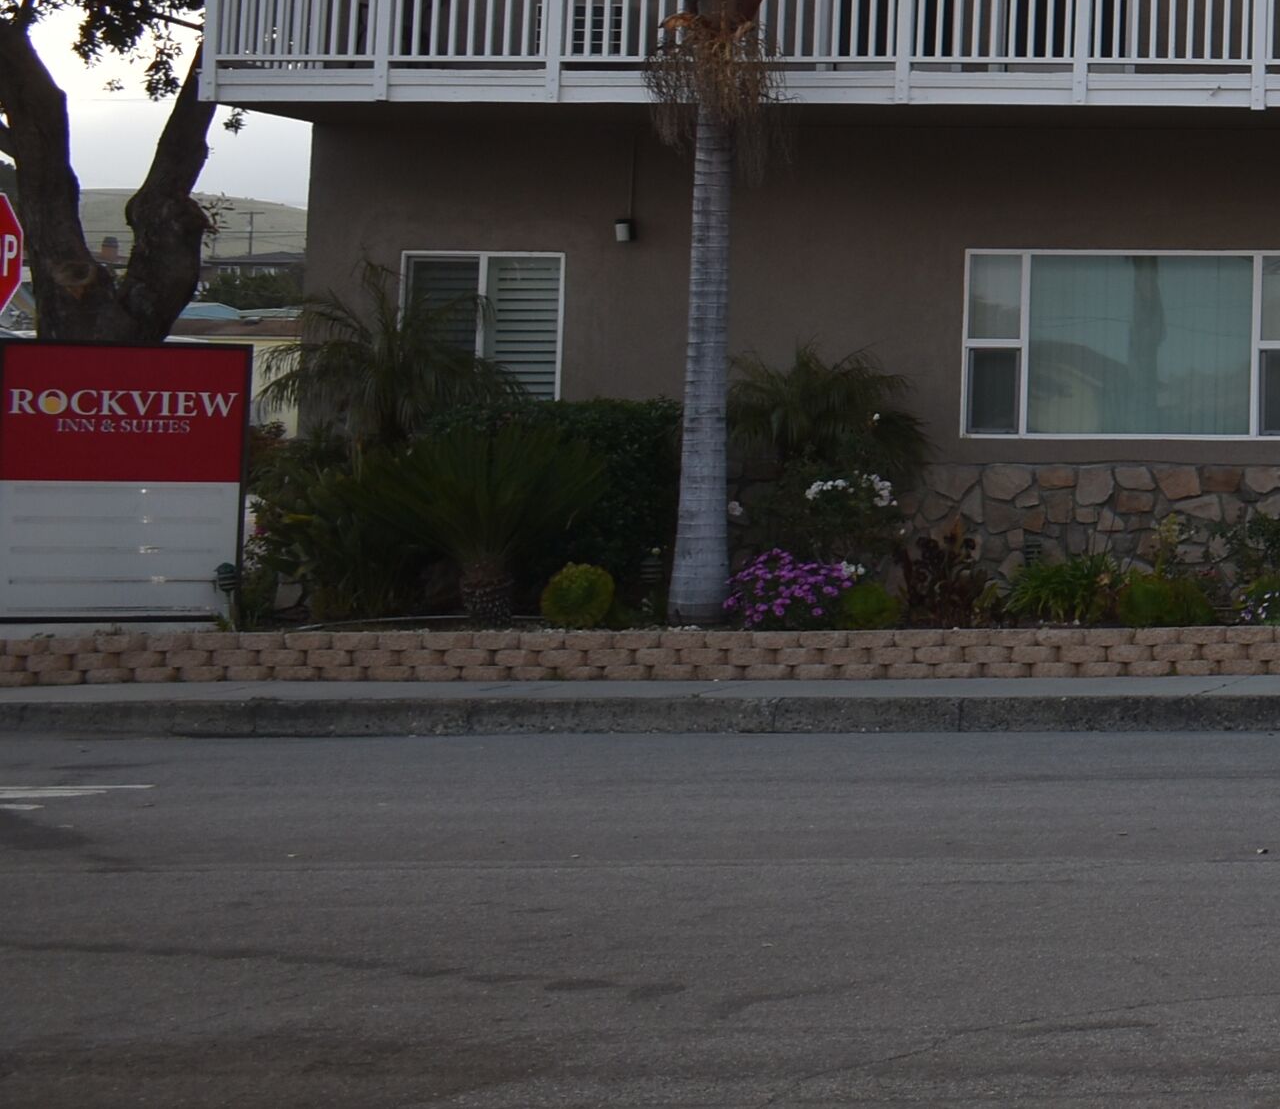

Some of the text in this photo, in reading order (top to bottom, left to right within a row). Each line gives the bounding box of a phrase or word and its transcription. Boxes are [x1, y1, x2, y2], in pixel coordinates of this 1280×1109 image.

[0, 234, 18, 277] P
[9, 388, 238, 418] ROCKVIEW
[57, 418, 190, 433] INN & SUITES
